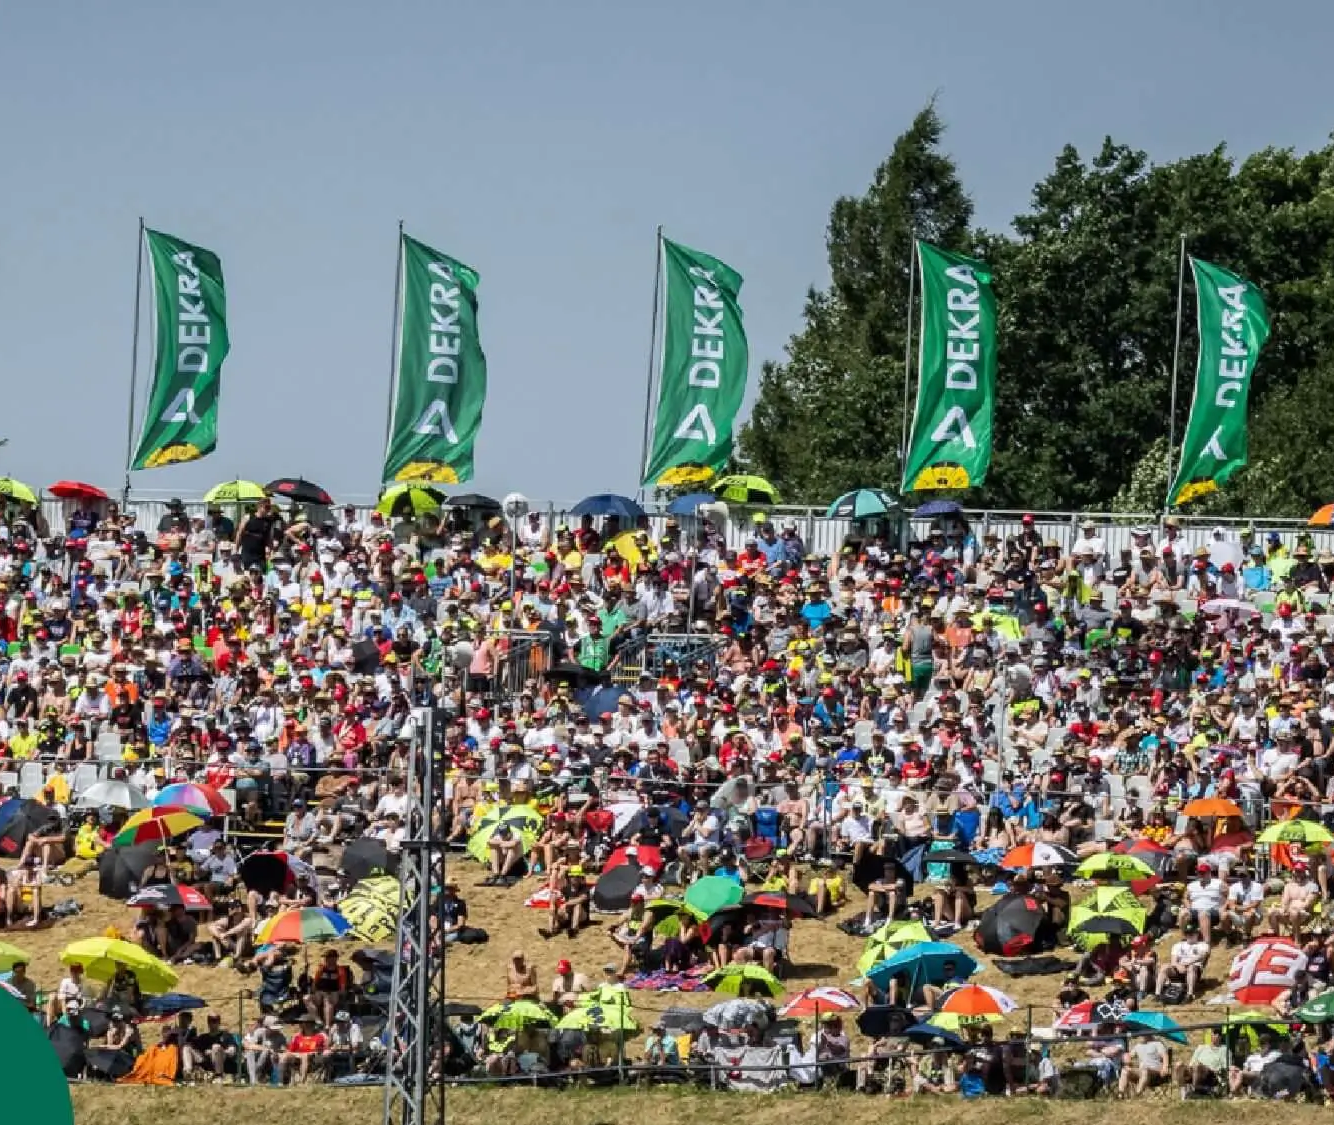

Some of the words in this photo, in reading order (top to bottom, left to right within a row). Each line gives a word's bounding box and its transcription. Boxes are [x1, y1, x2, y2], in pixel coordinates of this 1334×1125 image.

[174, 251, 211, 373] DEKRA
[428, 261, 460, 383] DEKRA
[945, 264, 979, 391] DEKRA
[1215, 283, 1248, 408] DEKRA
